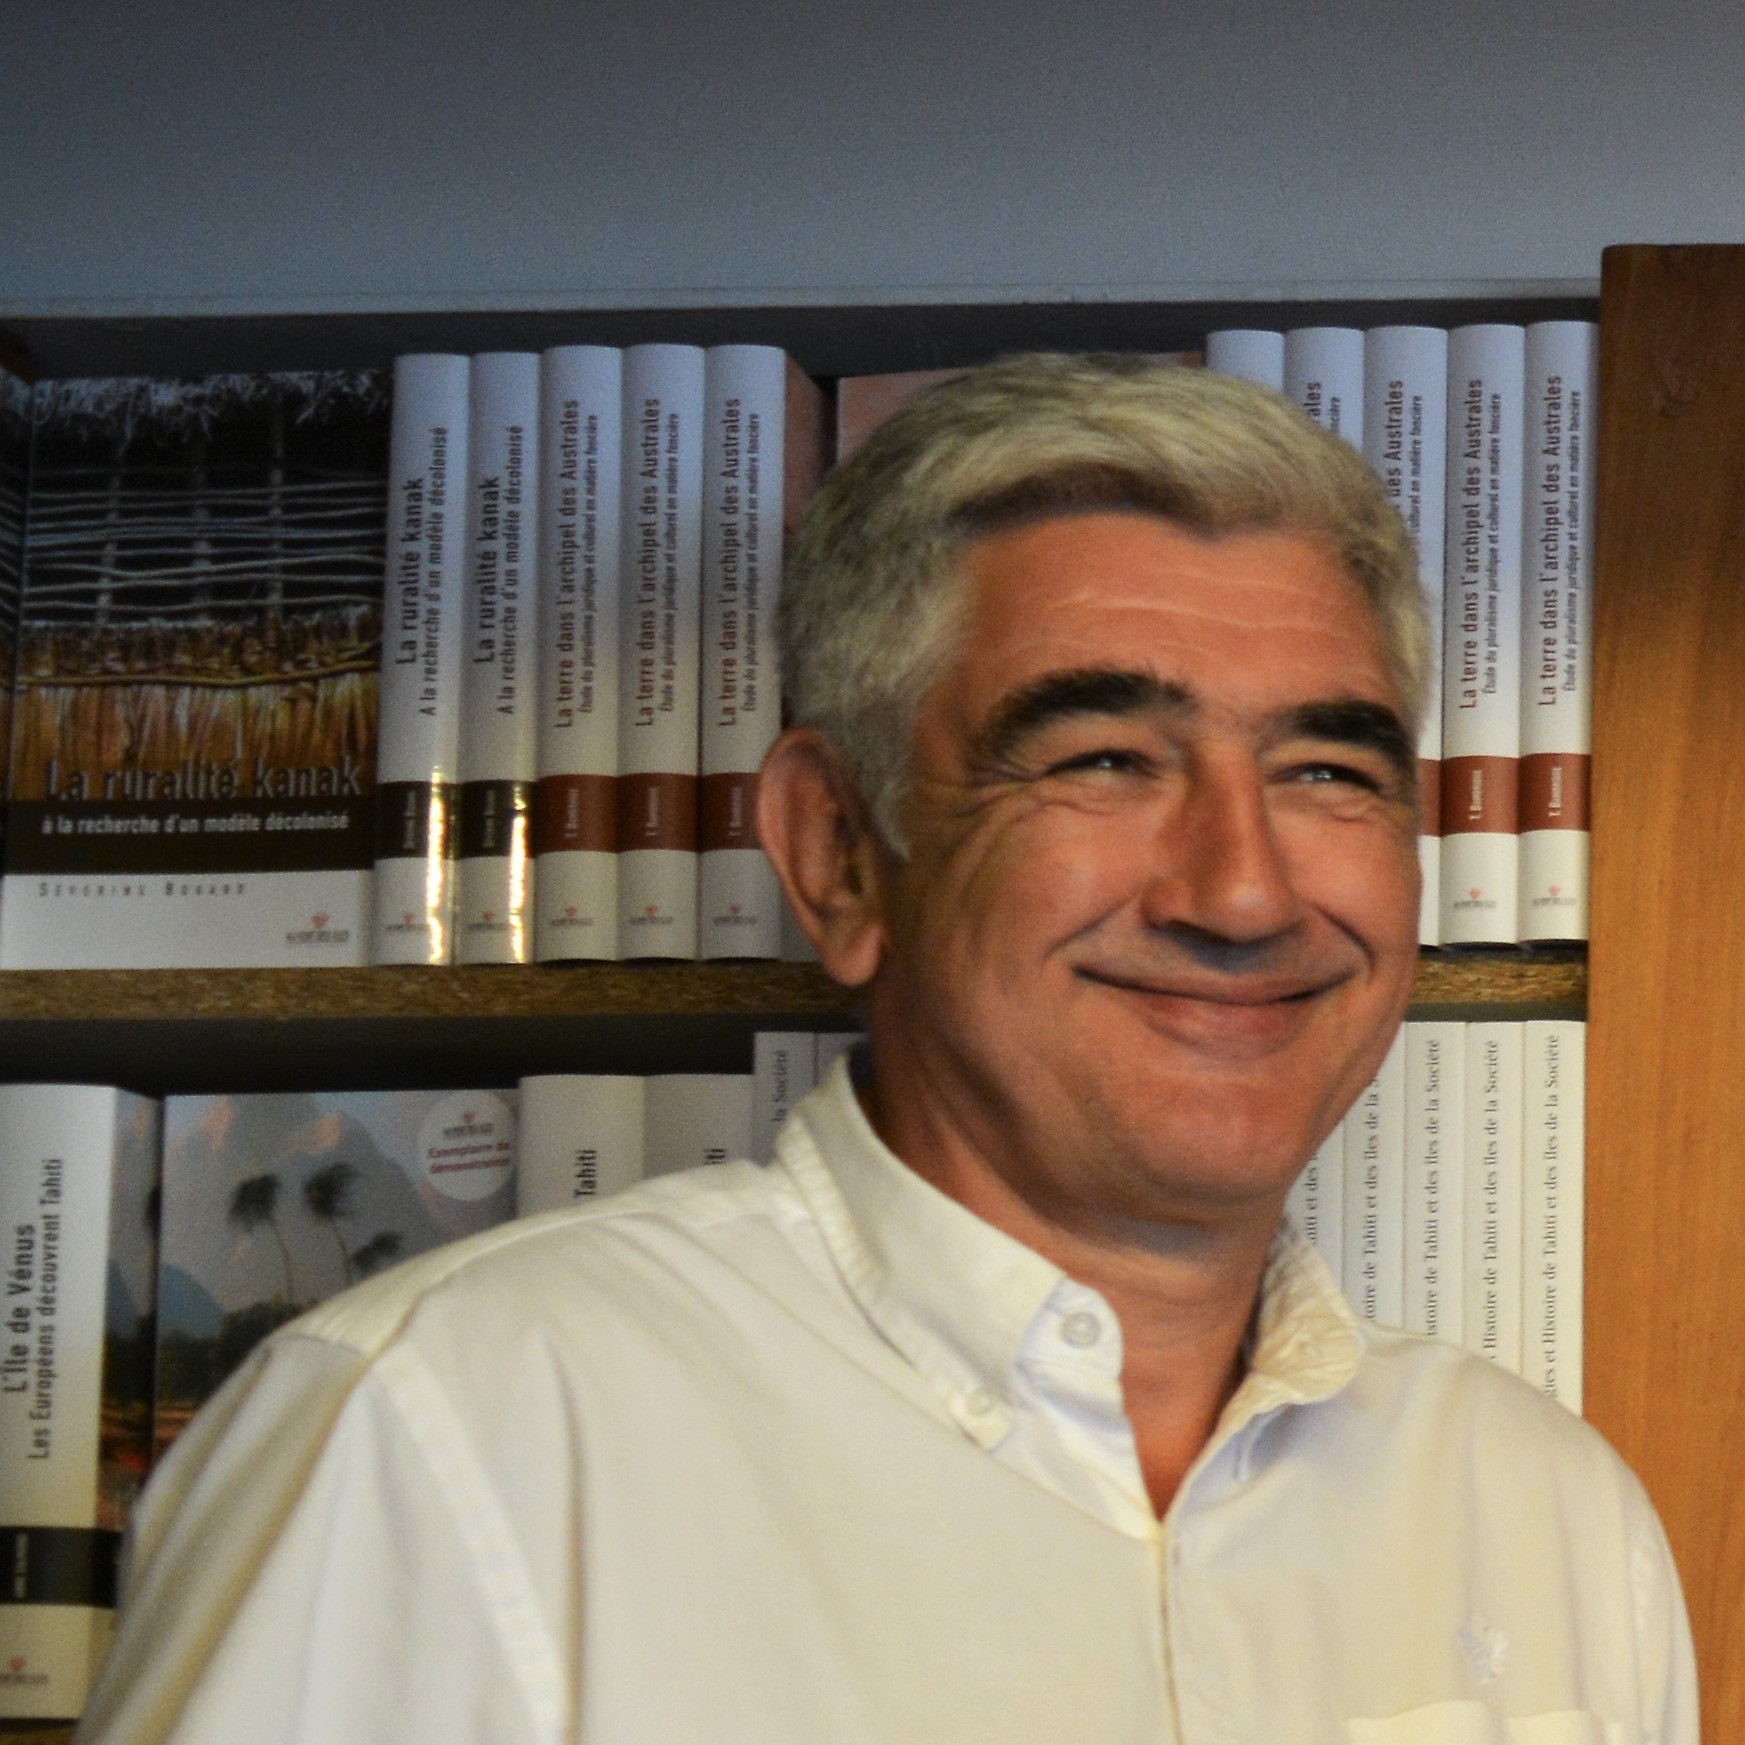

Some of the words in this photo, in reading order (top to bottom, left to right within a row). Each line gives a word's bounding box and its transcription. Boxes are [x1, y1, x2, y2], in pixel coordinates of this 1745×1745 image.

[1542, 375, 1562, 456] Australes
[426, 427, 447, 506] décolonisé
[1541, 463, 1559, 492] des
[399, 477, 424, 543] kanak
[424, 511, 443, 564] modèle
[1540, 500, 1563, 581] l'archipel
[395, 550, 421, 631] ruralité
[1539, 589, 1557, 629] dans
[395, 639, 416, 664] La
[420, 607, 439, 681] recherche
[1539, 637, 1556, 678] terre
[420, 687, 436, 700] la
[1538, 686, 1556, 705] La
[103, 753, 240, 800] ruralité
[256, 757, 363, 799] kanak
[78, 815, 159, 834] recherche
[204, 812, 260, 833] modèle
[265, 811, 349, 832] décolonisé
[1545, 1035, 1558, 1088] Société
[1545, 1094, 1557, 1108] la
[1545, 1114, 1557, 1129] de
[40, 1158, 63, 1206] Tahiti
[573, 1147, 598, 1199] Tahiti
[1544, 1165, 1557, 1189] des
[1543, 1214, 1557, 1257] Tahiti
[5, 1223, 35, 1296] Vénus
[34, 1214, 62, 1317] découvrent
[1543, 1264, 1556, 1280] de
[4, 1306, 30, 1334] de
[1542, 1285, 1556, 1344] Histoire
[28, 1323, 59, 1420] Européens
[27, 1427, 51, 1459] Les
